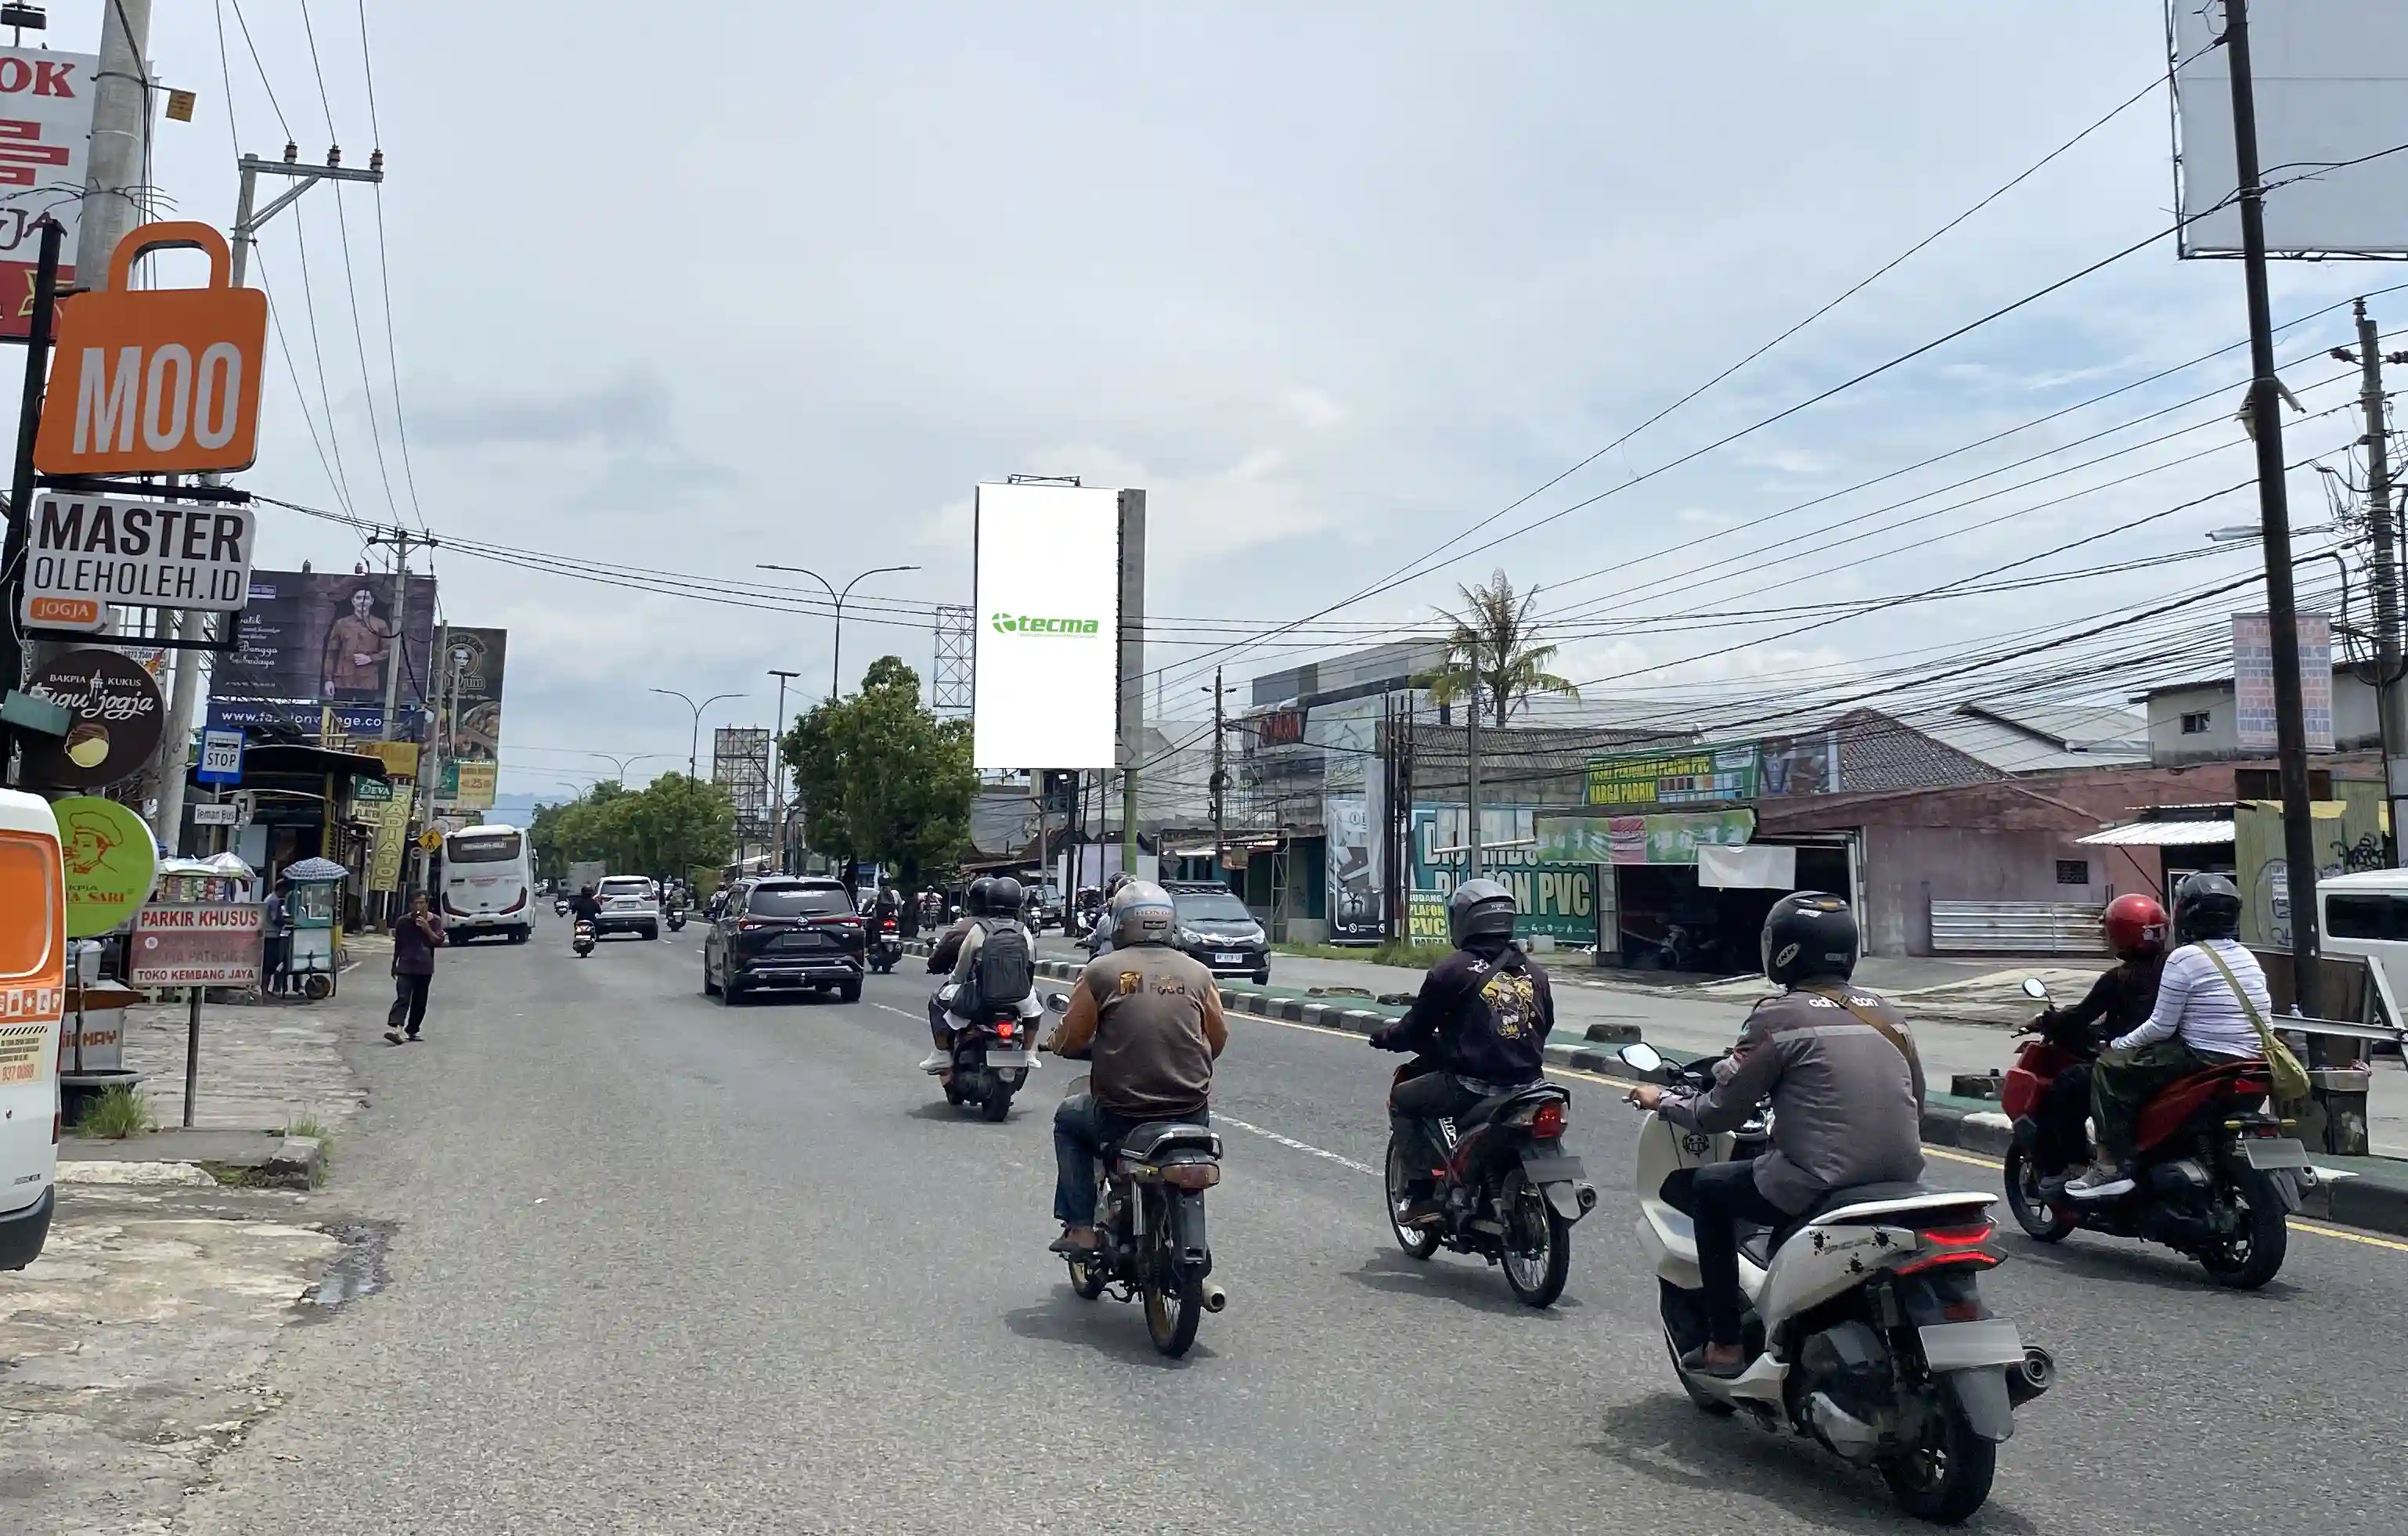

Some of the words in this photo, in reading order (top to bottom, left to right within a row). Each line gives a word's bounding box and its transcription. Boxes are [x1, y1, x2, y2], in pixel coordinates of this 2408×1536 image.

[73, 342, 242, 454] MOO
[39, 502, 243, 563] MASTER
[34, 557, 241, 601] OLEHOLEH.ID
[38, 601, 90, 618] JOGJA
[1018, 615, 1099, 633] tecma
[49, 674, 86, 684] BAKPIA
[108, 678, 142, 687] KUKUS
[207, 752, 236, 766] STOP
[196, 809, 220, 820] Teman
[1538, 871, 1592, 917] PVC
[142, 910, 193, 926] PARKIR
[199, 910, 258, 926] KHUSUS
[1409, 904, 1445, 917] PLAFON
[1409, 918, 1447, 936] PVC
[138, 970, 168, 981] TOKO
[171, 970, 225, 981] KEMBANG
[229, 969, 254, 979] JAYA
